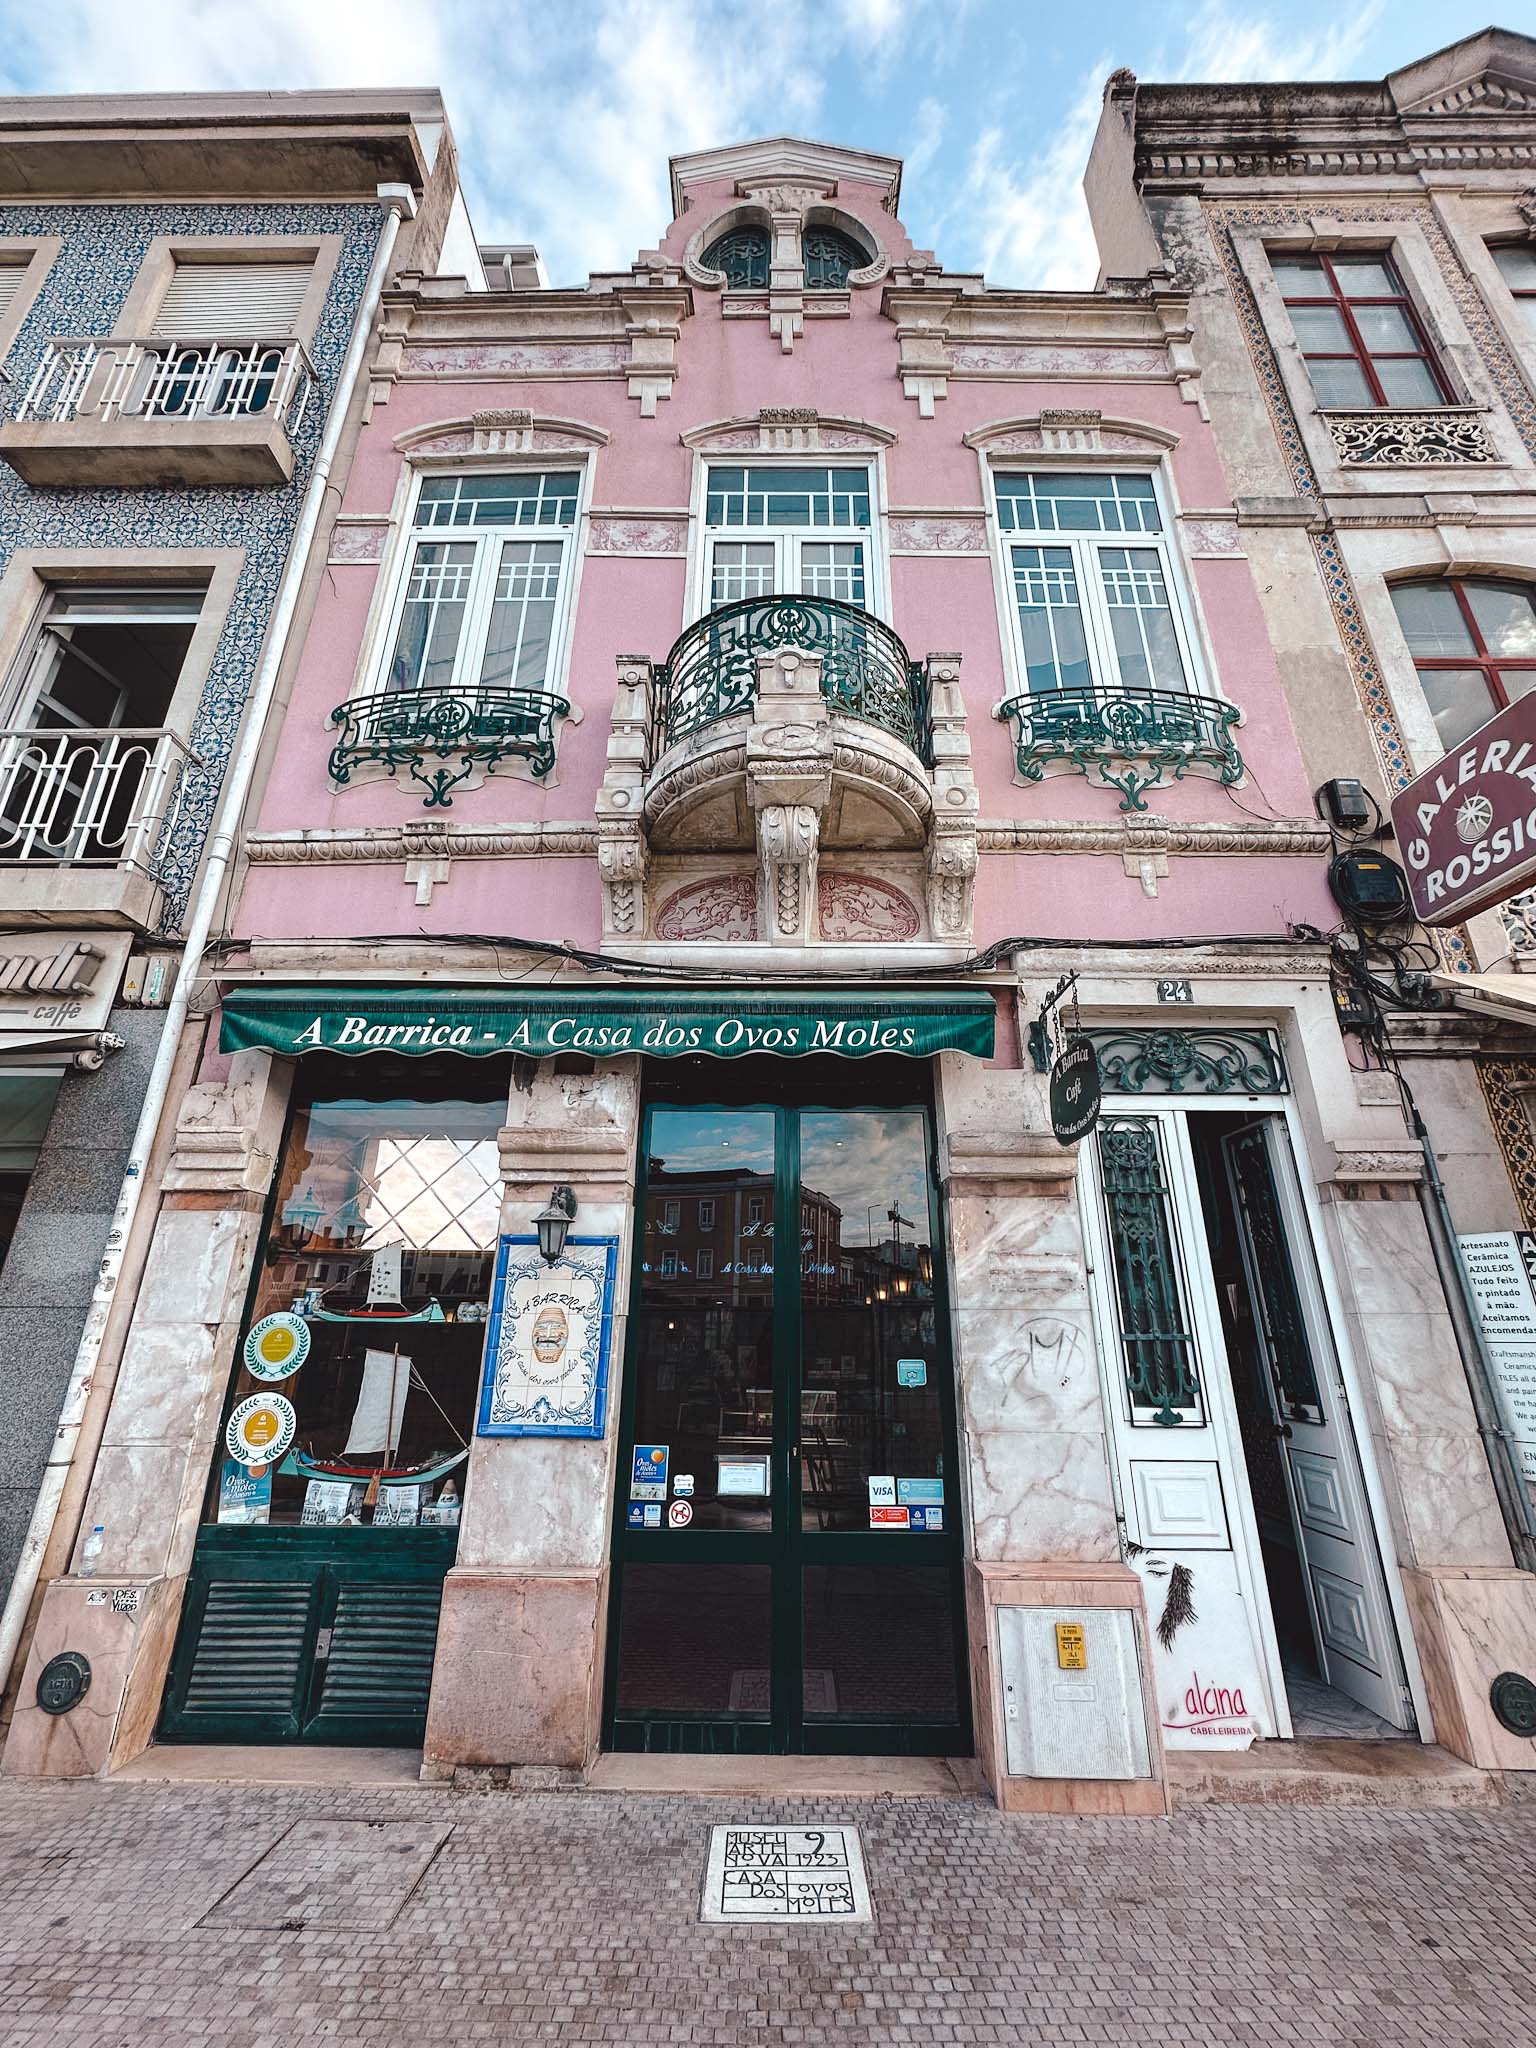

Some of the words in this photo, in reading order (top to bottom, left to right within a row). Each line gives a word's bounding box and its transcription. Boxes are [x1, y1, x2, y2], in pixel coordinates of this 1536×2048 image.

[1163, 981, 1187, 1001] 24
[292, 1016, 324, 1046] A
[334, 1016, 472, 1047] Barrica
[505, 1018, 532, 1047] A
[547, 1017, 634, 1048] Casa
[643, 1019, 702, 1048] dos
[714, 1018, 799, 1048] Ovos
[810, 1019, 916, 1048] Moles
[1061, 1046, 1089, 1074] Barrica
[1460, 1241, 1510, 1250] Artesanato
[1467, 1252, 1509, 1262] Cerâmica
[1469, 1264, 1514, 1273] AZULEJOS
[1472, 1277, 1494, 1285] Tudo
[1497, 1276, 1519, 1284] feito
[1485, 1289, 1521, 1299] pintado
[523, 1300, 531, 1314] A
[531, 1292, 586, 1314] BARRICA
[1495, 1301, 1519, 1309] mão.
[1482, 1313, 1531, 1322] Aceitamos
[1498, 1374, 1519, 1382] TILES
[225, 1474, 247, 1488] Ovos
[230, 1479, 257, 1493] moles
[872, 1486, 893, 1496] VISA
[1185, 1670, 1248, 1716] alcina
[1190, 1727, 1253, 1736] CABELEIREIRA
[728, 1832, 785, 1844] MUSEU
[729, 1843, 785, 1855] ARTE
[725, 1854, 785, 1867] NOVA
[795, 1854, 839, 1867] 1923
[724, 1871, 777, 1885] CASA
[751, 1884, 786, 1898] DOS
[798, 1884, 850, 1899] OVOS
[788, 1898, 856, 1914] MOLES
